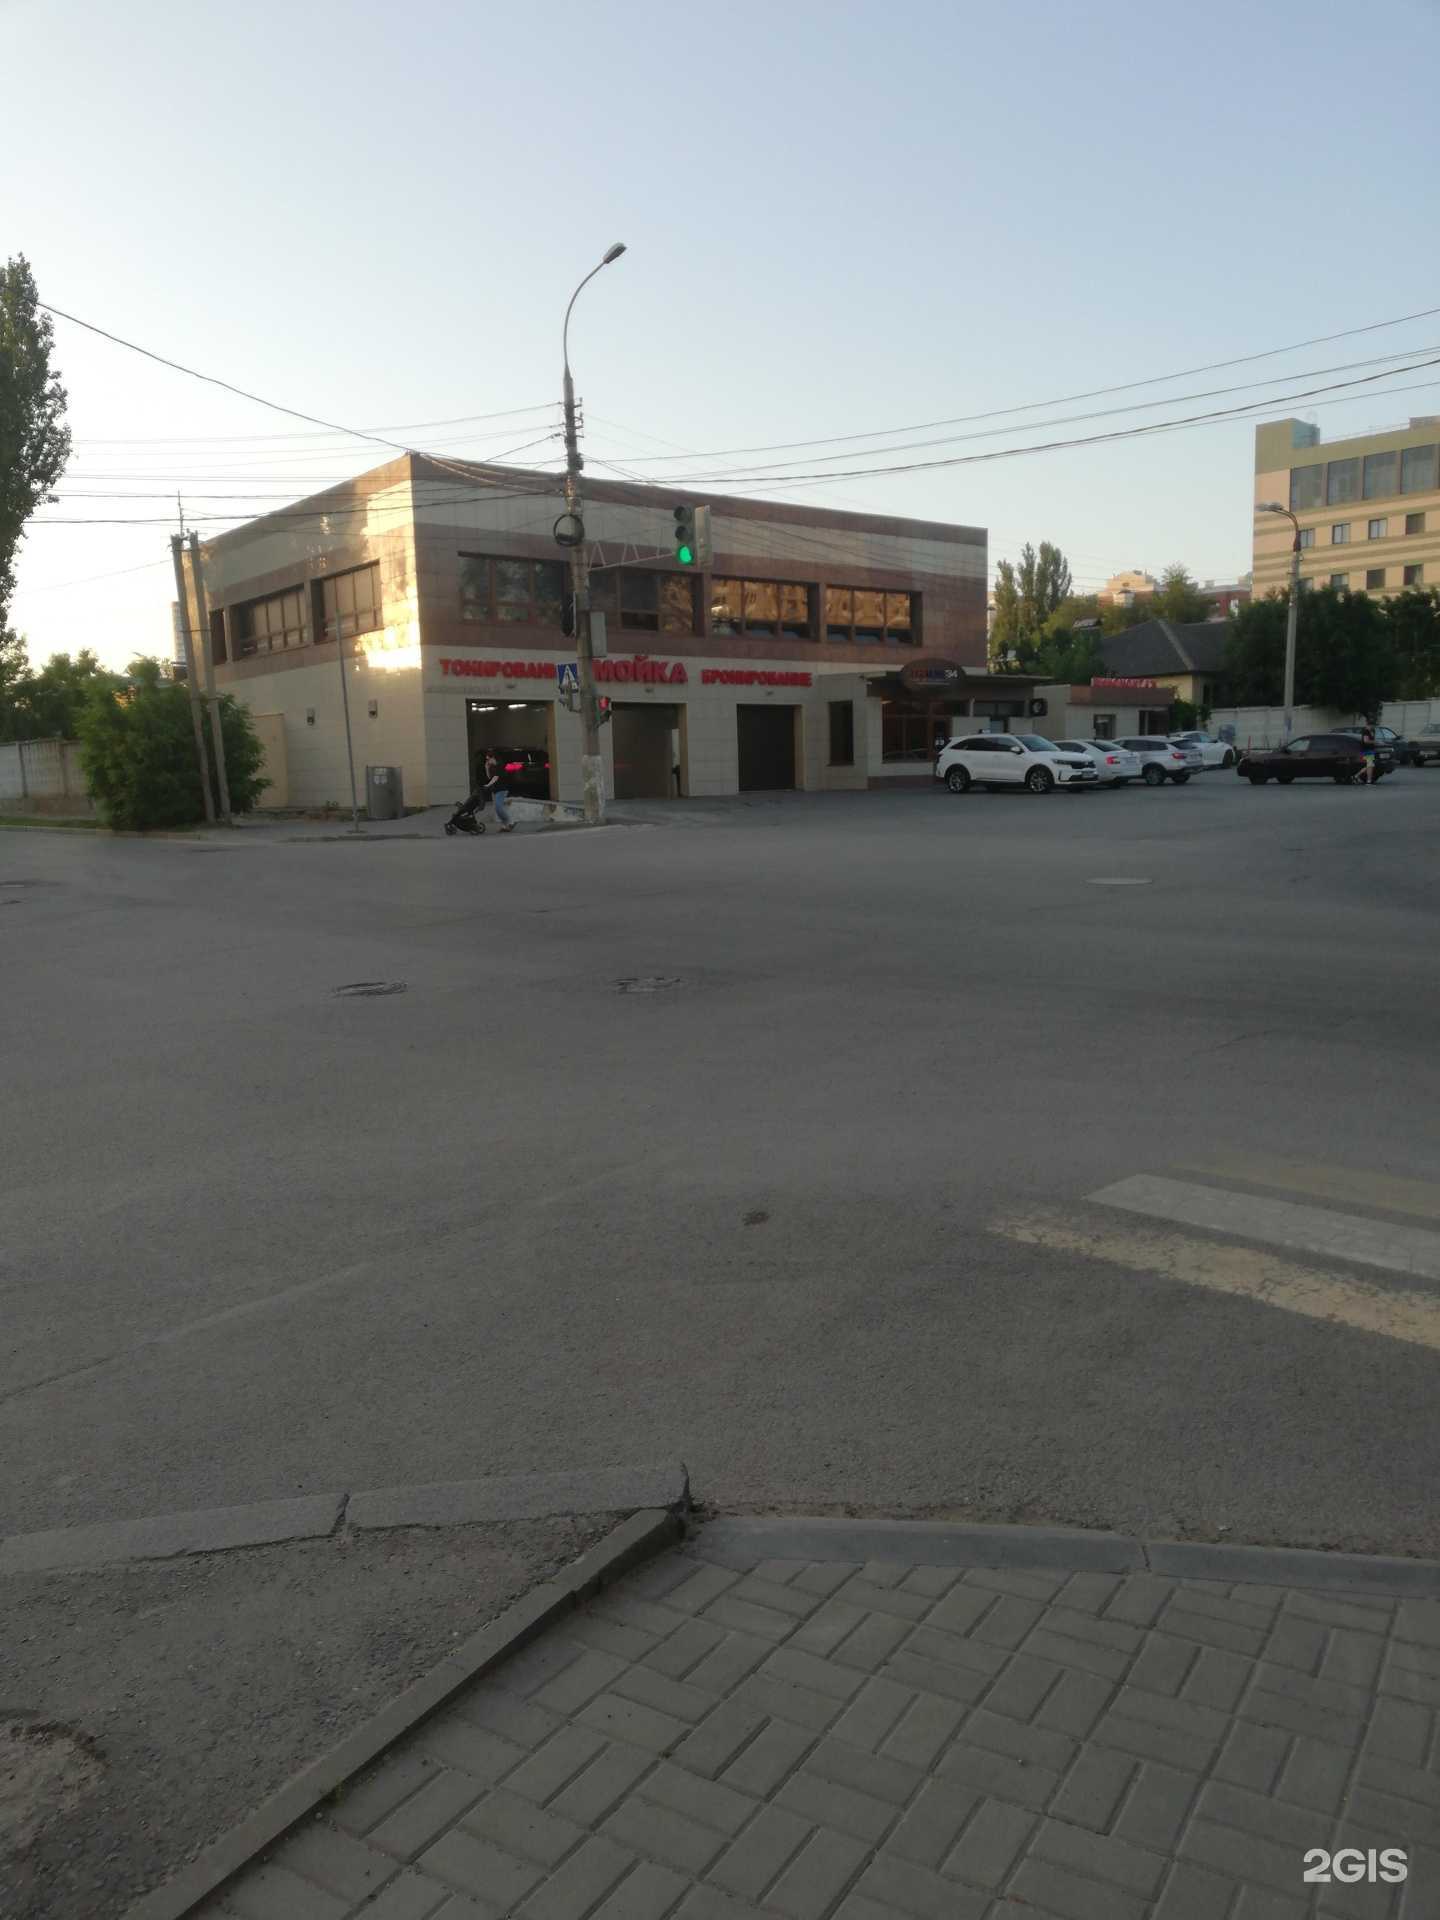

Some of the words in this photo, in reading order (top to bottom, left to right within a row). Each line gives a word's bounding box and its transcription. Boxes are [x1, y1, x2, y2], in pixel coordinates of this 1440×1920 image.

[440, 658, 557, 679] ТОНИРОВАНИ
[592, 655, 688, 683] МОЙКА
[702, 668, 812, 688] БРОНИРОВАНИЕ
